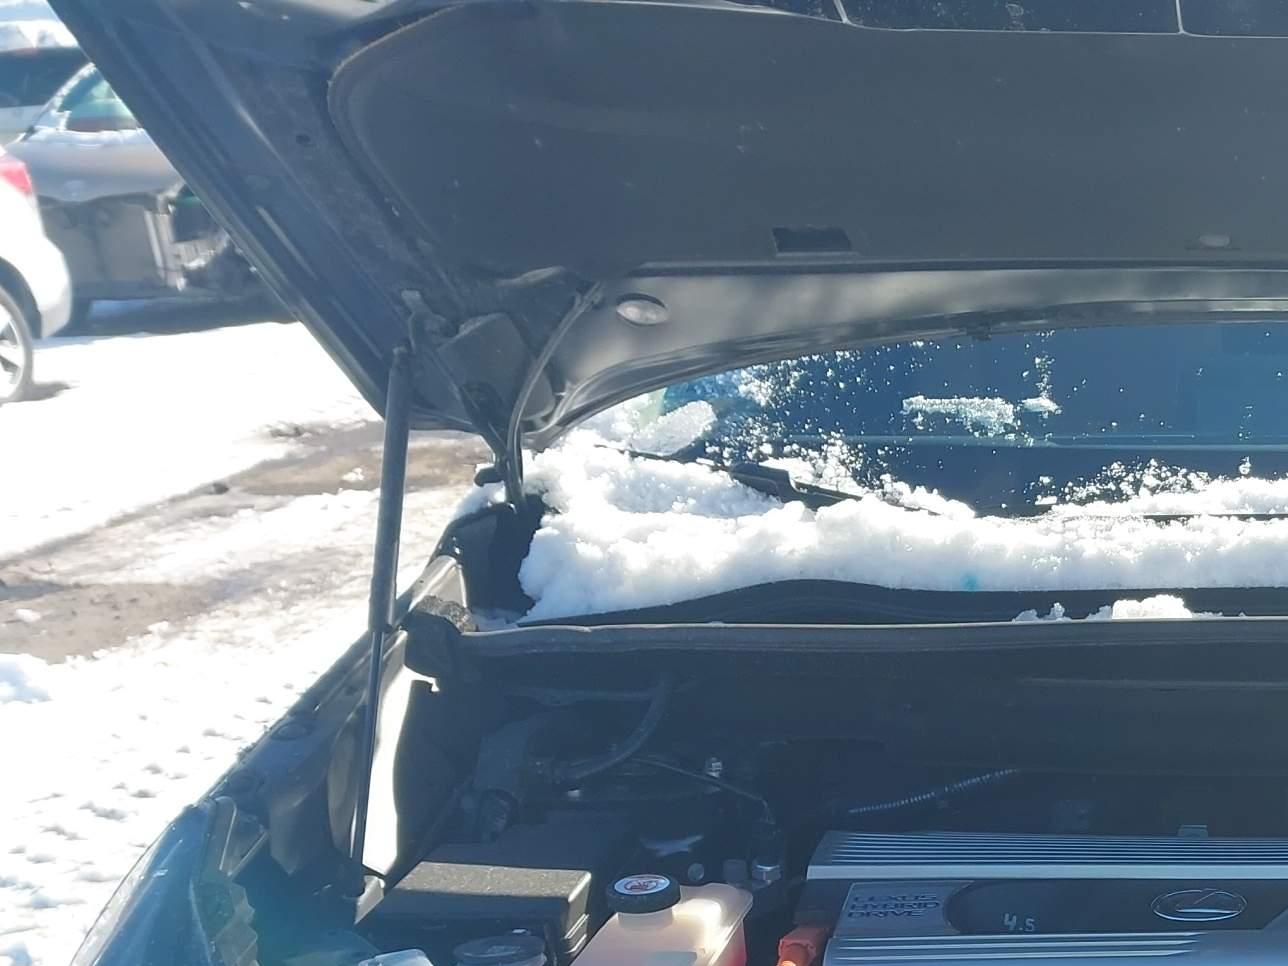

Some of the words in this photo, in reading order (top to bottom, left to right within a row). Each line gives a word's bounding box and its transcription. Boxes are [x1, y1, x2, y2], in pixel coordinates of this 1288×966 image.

[852, 893, 938, 902] LEXUS
[849, 901, 941, 910] HYBRID
[847, 910, 926, 918] DRIVE
